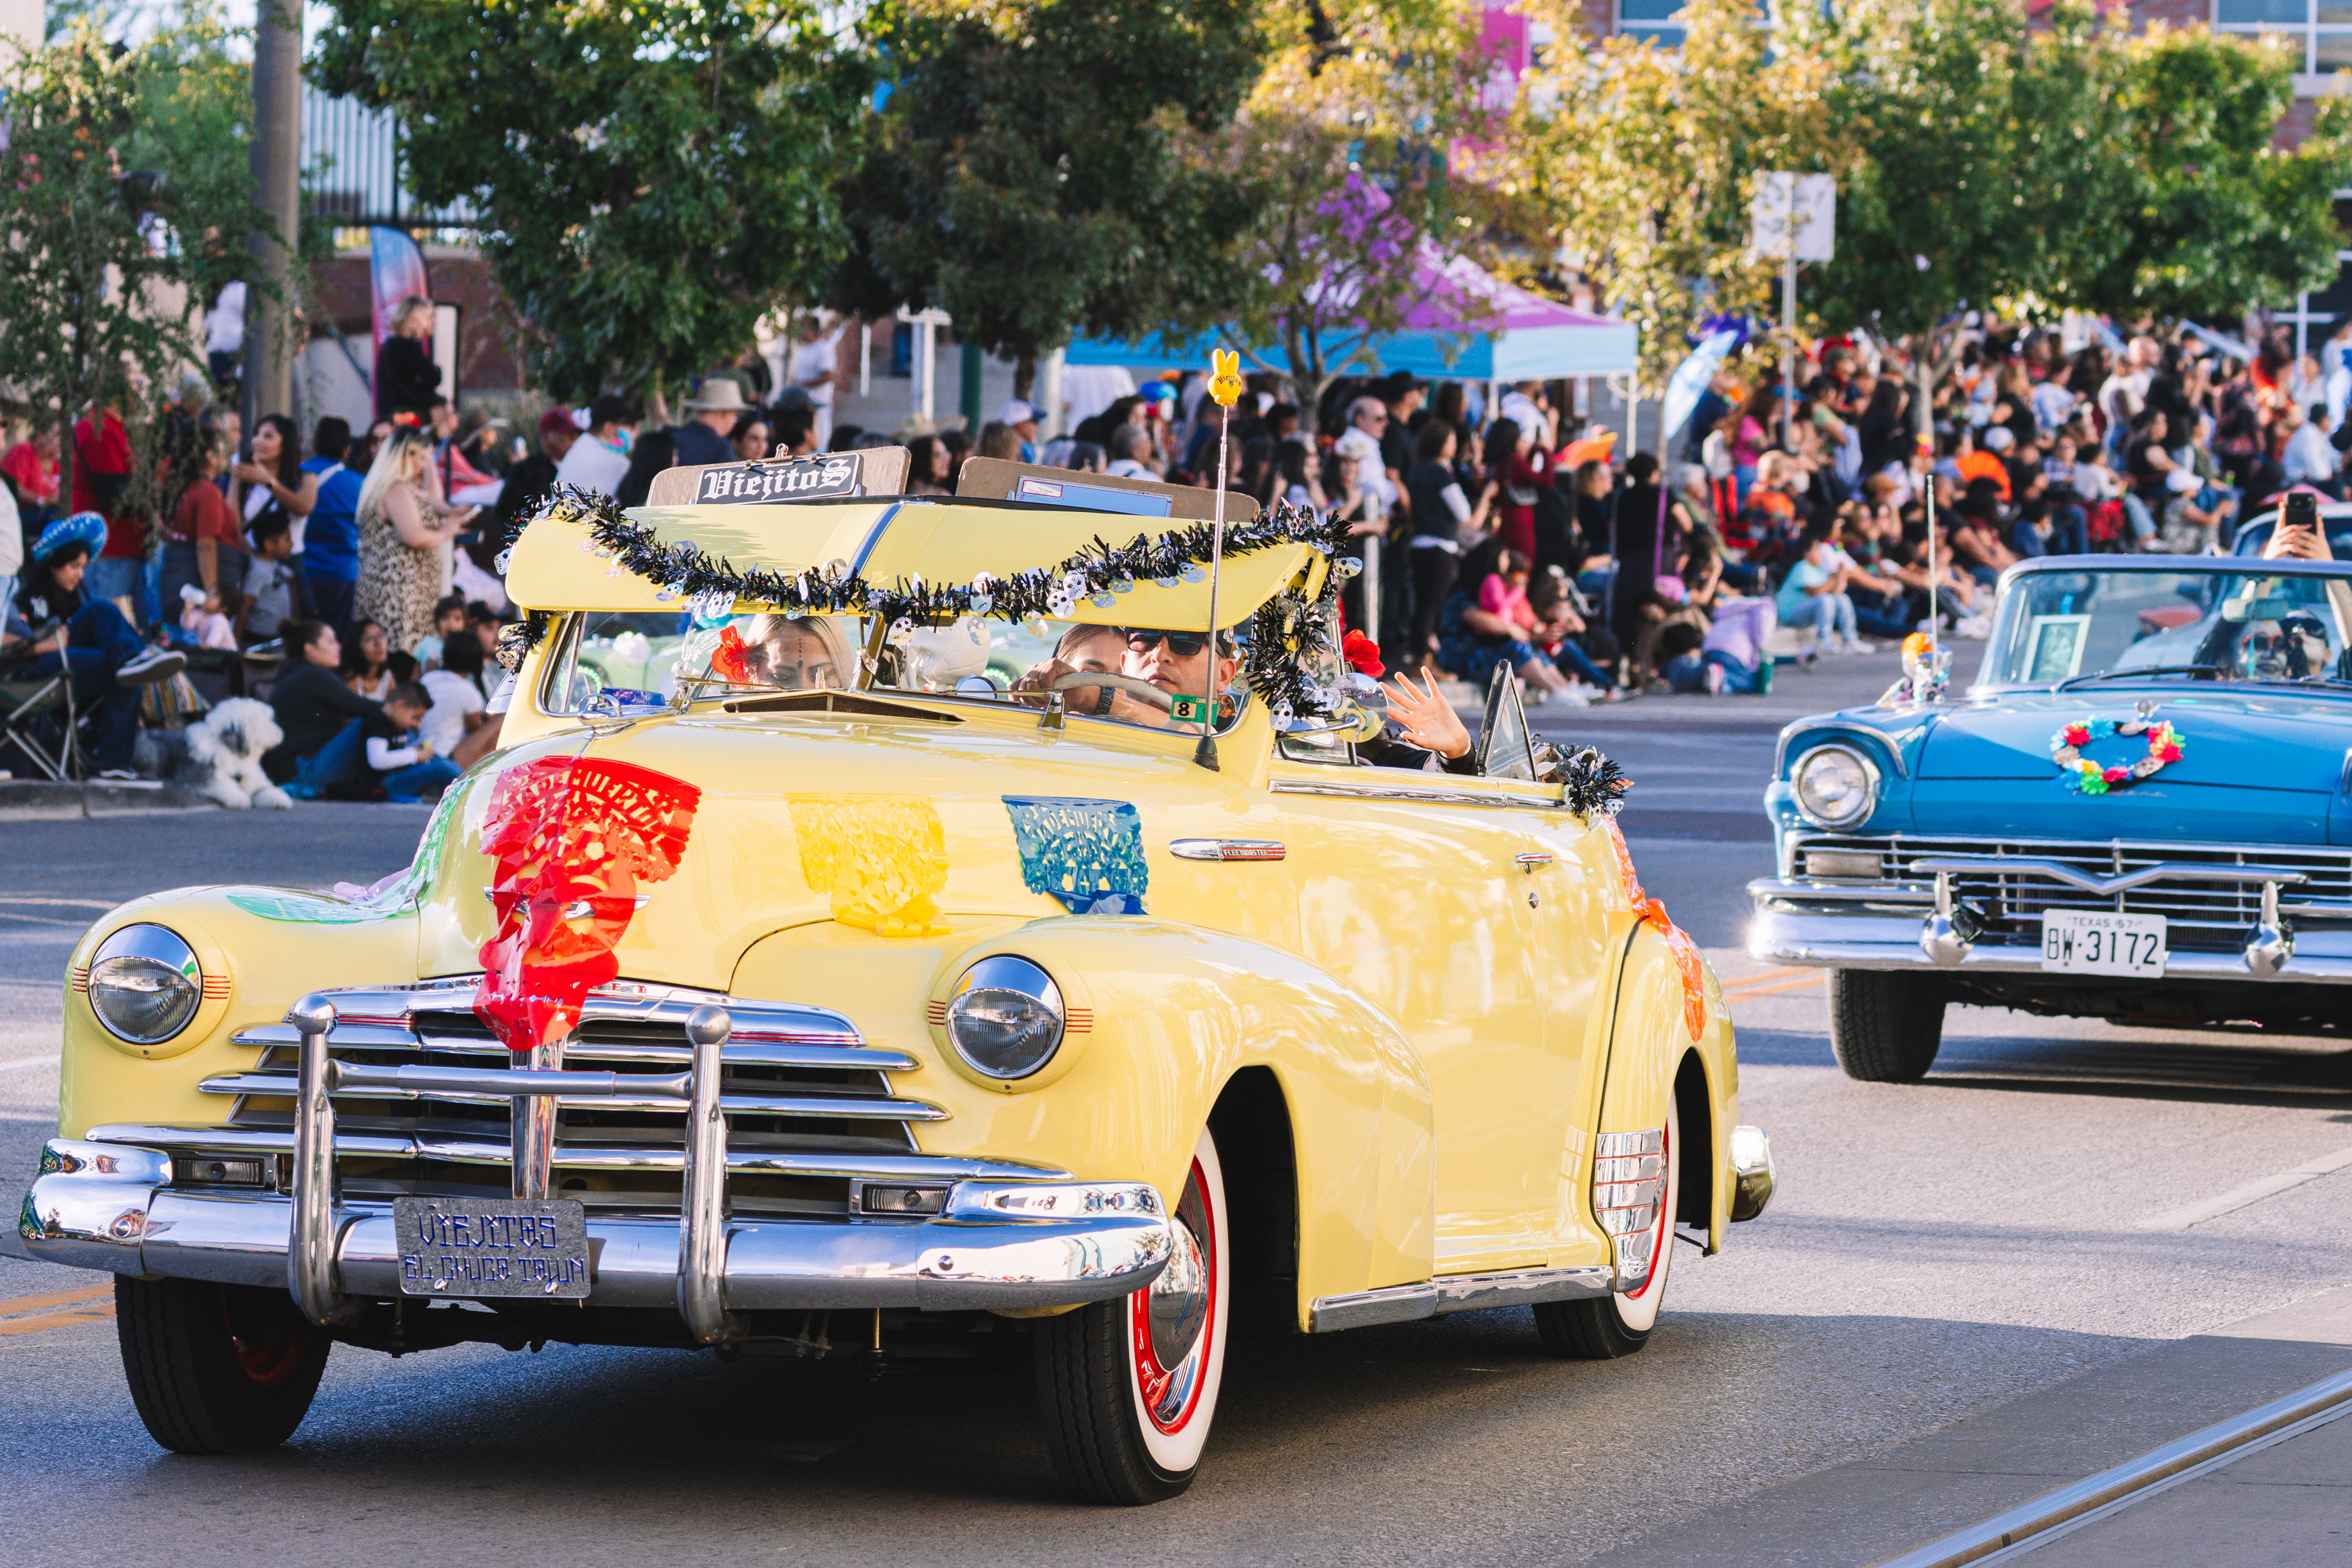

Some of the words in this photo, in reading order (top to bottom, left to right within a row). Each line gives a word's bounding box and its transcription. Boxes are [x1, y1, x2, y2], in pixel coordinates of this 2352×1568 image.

[1178, 702, 1190, 717] 8
[2073, 916, 2111, 927] TEXAS
[419, 1213, 557, 1249] VIEJITOS
[405, 1254, 434, 1279] EL
[441, 1256, 511, 1282] CHUCO
[517, 1258, 586, 1283] TOWN
